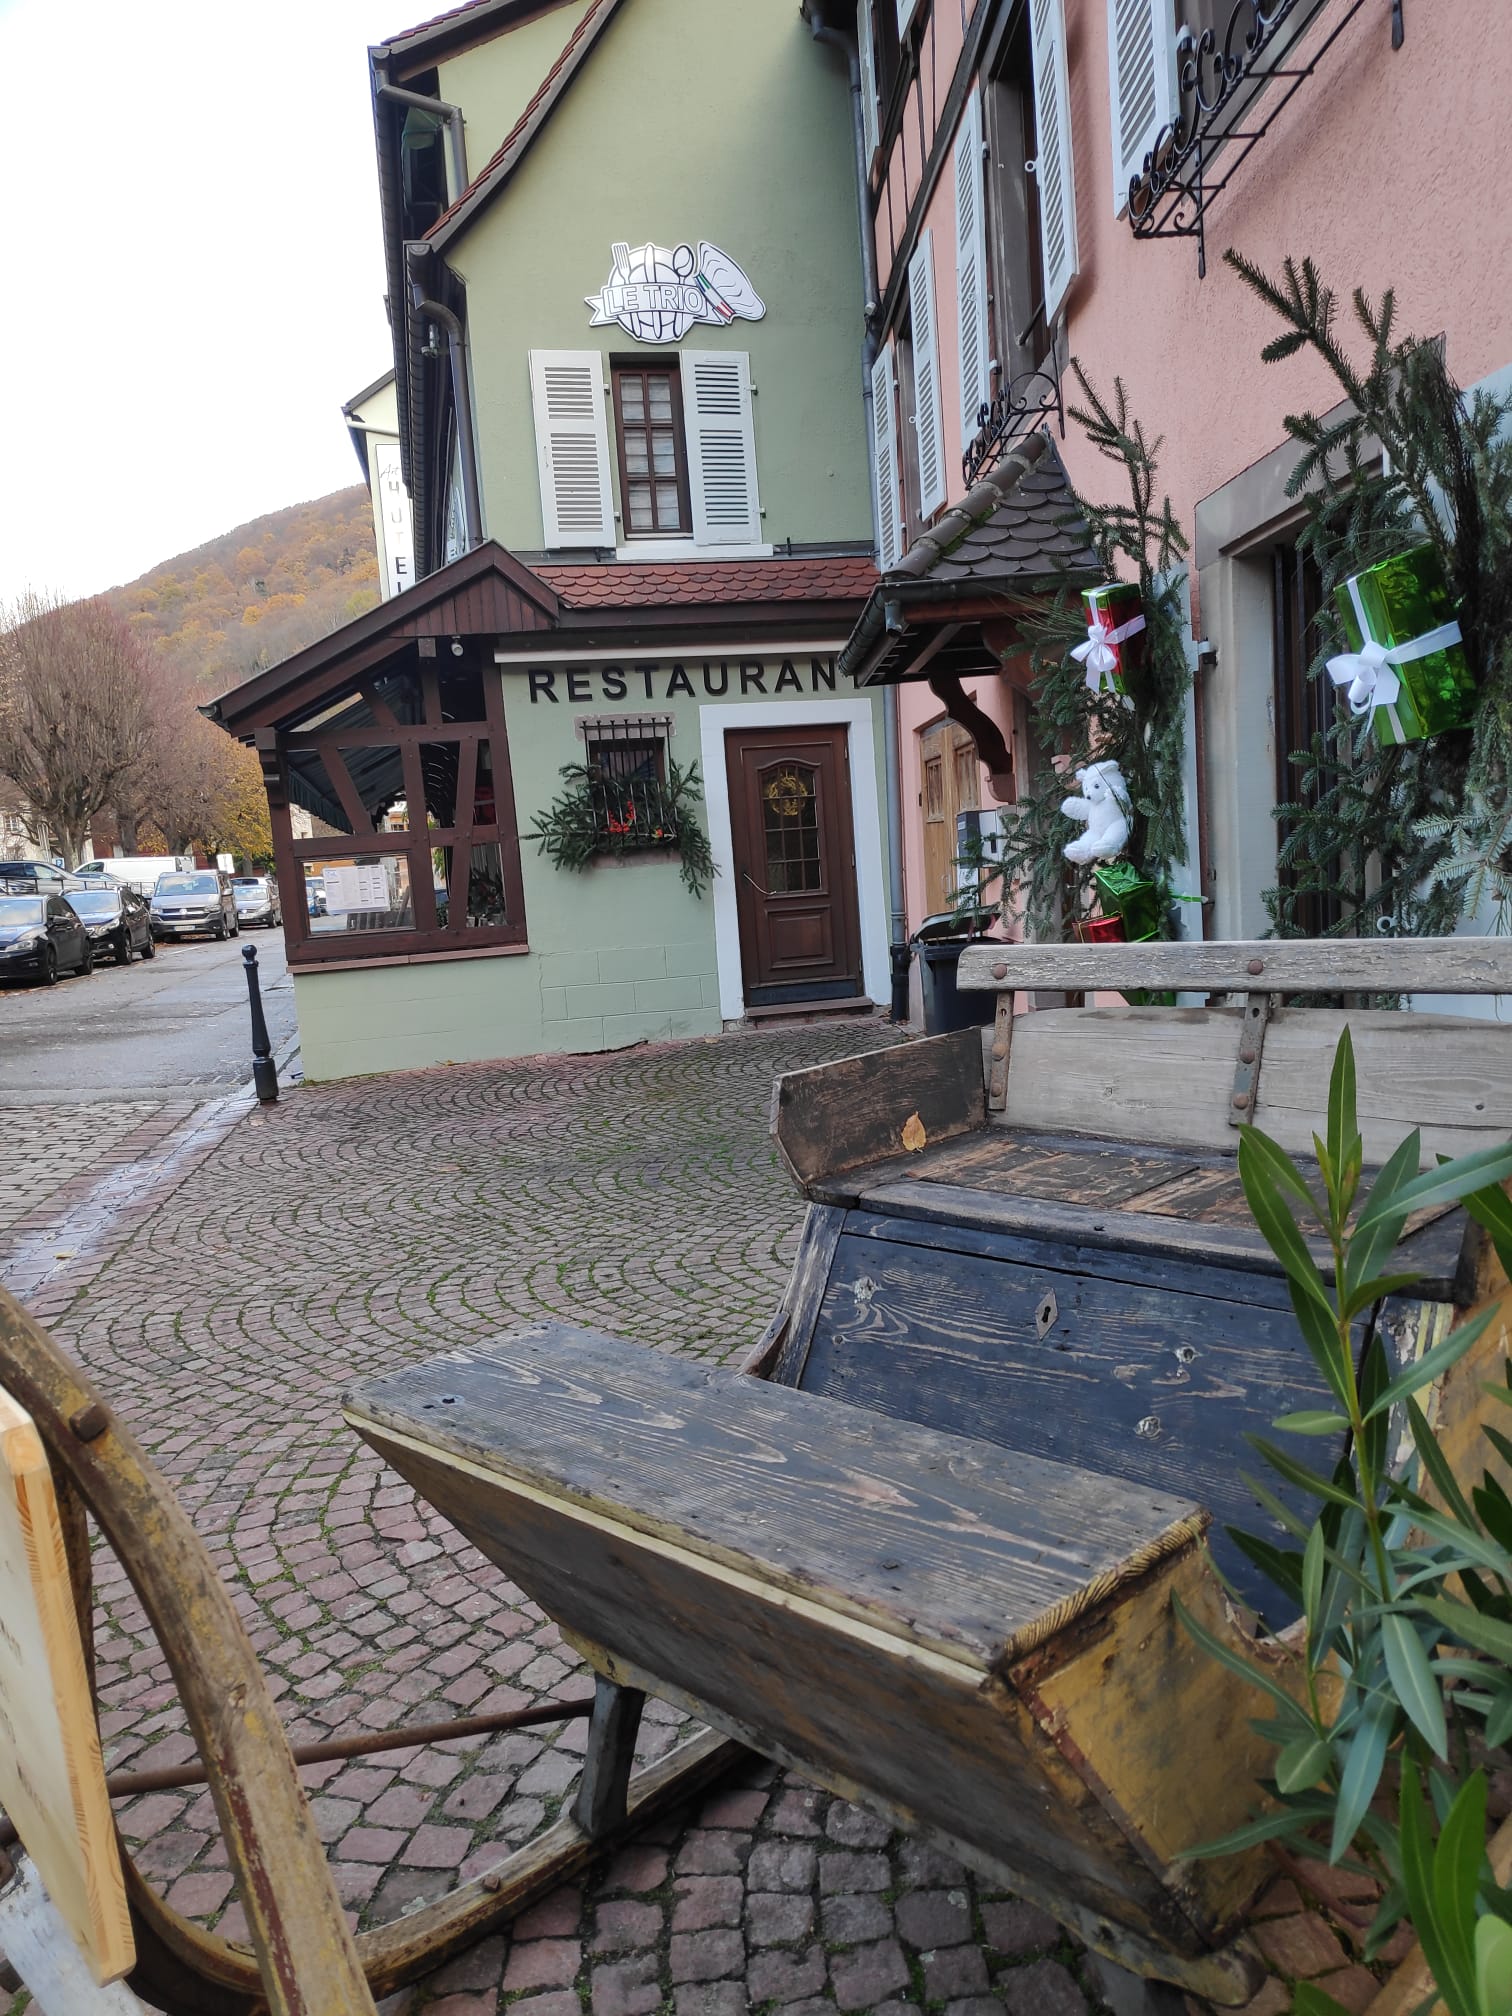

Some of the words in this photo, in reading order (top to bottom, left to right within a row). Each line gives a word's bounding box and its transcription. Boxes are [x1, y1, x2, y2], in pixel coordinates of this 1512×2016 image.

[607, 285, 639, 314] LE
[643, 284, 703, 313] TRIO
[528, 656, 861, 704] RESTAURAN
